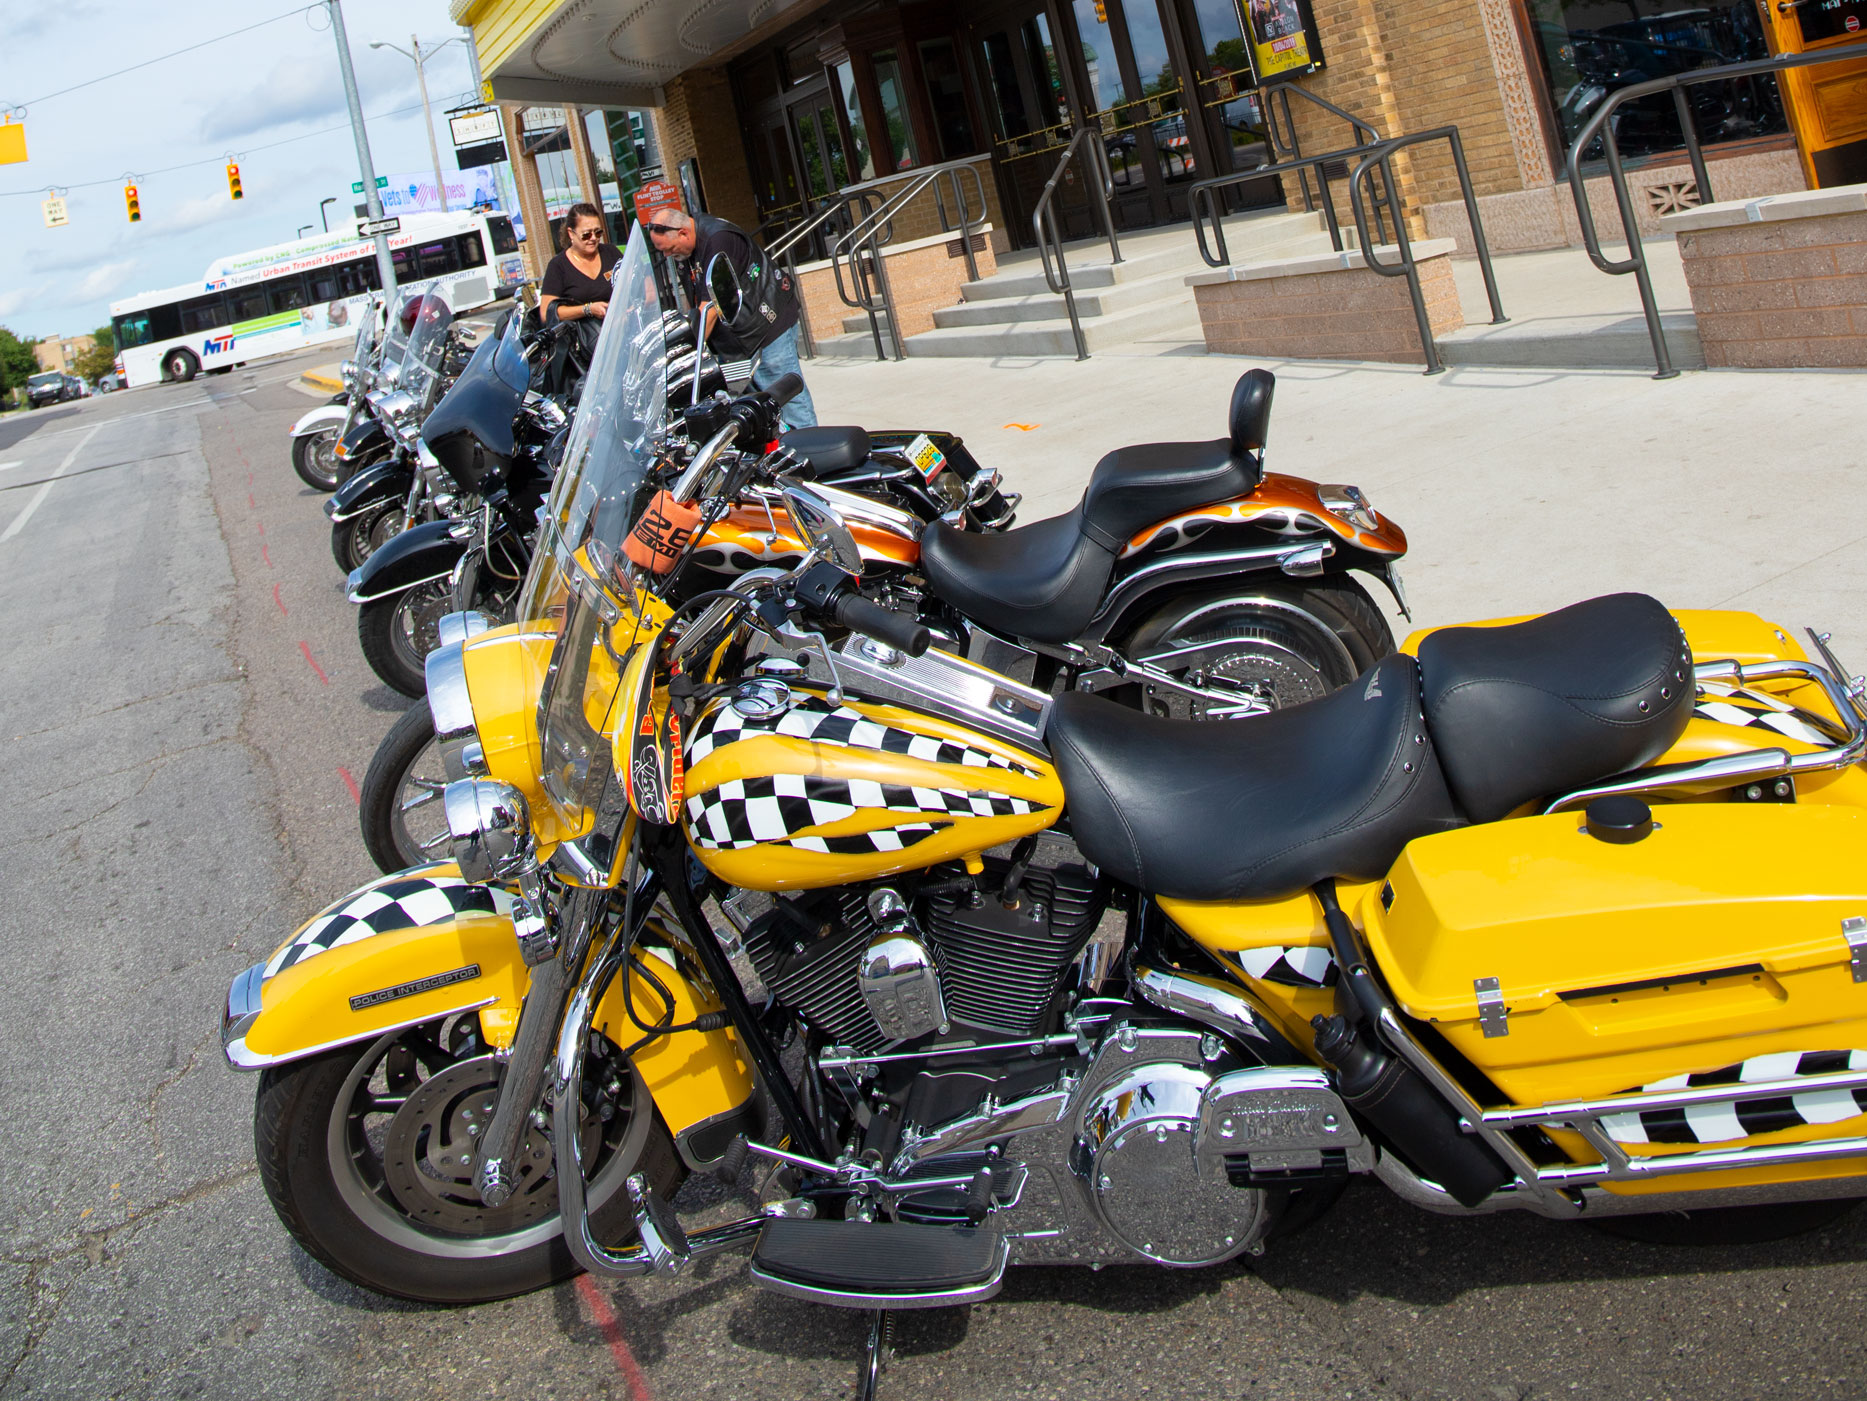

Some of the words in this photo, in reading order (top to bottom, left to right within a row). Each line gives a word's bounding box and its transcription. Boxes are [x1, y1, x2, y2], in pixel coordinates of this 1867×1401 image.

[230, 272, 261, 285] Named
[263, 265, 290, 278] Urban
[292, 257, 323, 270] Transit
[324, 249, 358, 265] System
[360, 244, 370, 256] of
[640, 507, 692, 550] 26
[353, 990, 394, 1007] POLICE
[397, 967, 476, 996] INTERCEPTOR
